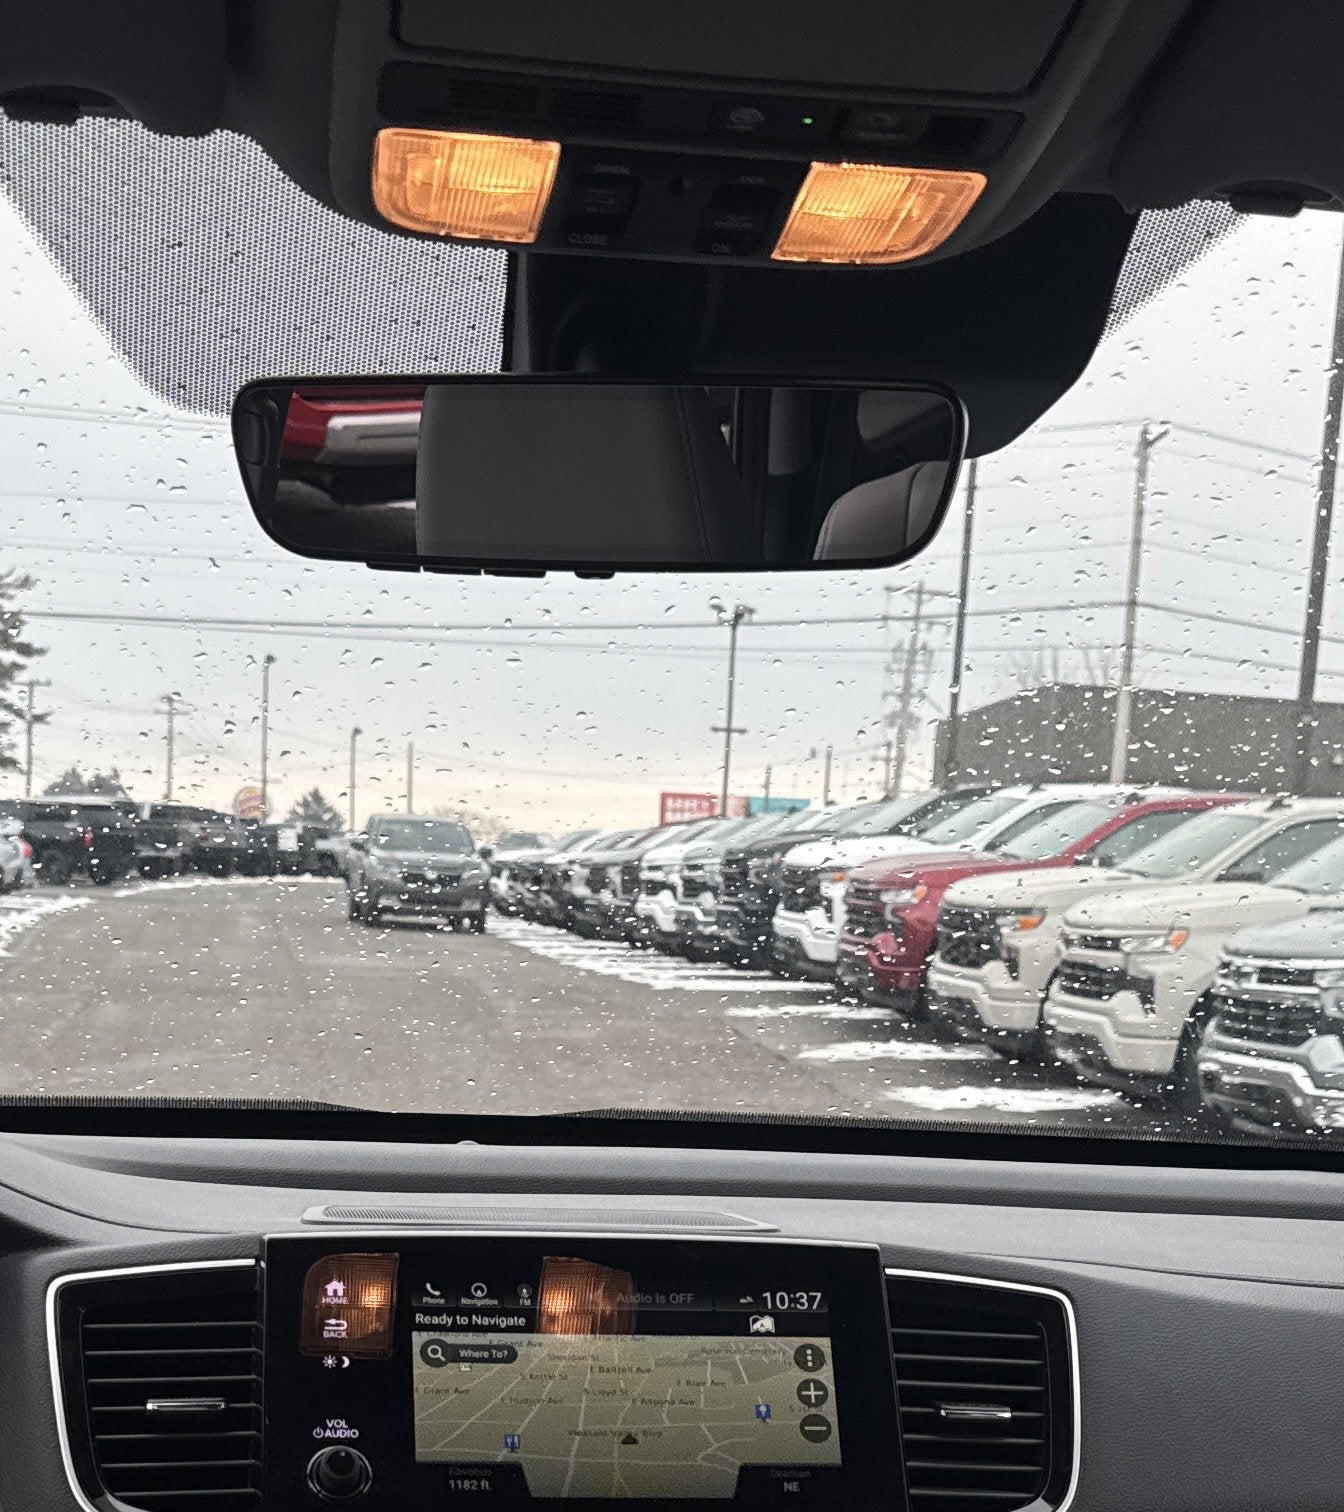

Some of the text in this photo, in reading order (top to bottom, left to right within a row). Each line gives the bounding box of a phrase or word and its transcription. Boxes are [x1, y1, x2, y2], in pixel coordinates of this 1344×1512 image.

[322, 1296, 348, 1305] HOME
[422, 1297, 445, 1305] Phone
[461, 1297, 498, 1307] Navigation
[616, 1292, 695, 1305] Audio is OFF
[761, 1291, 822, 1310] 10:37
[415, 1313, 526, 1329] Ready to Navigate
[323, 1330, 347, 1339] BACK
[459, 1349, 508, 1359] Where To?
[326, 1420, 348, 1429] VOL
[325, 1429, 359, 1438] AUDIO
[448, 1479, 479, 1491] 1182
[783, 1482, 800, 1492] NE
